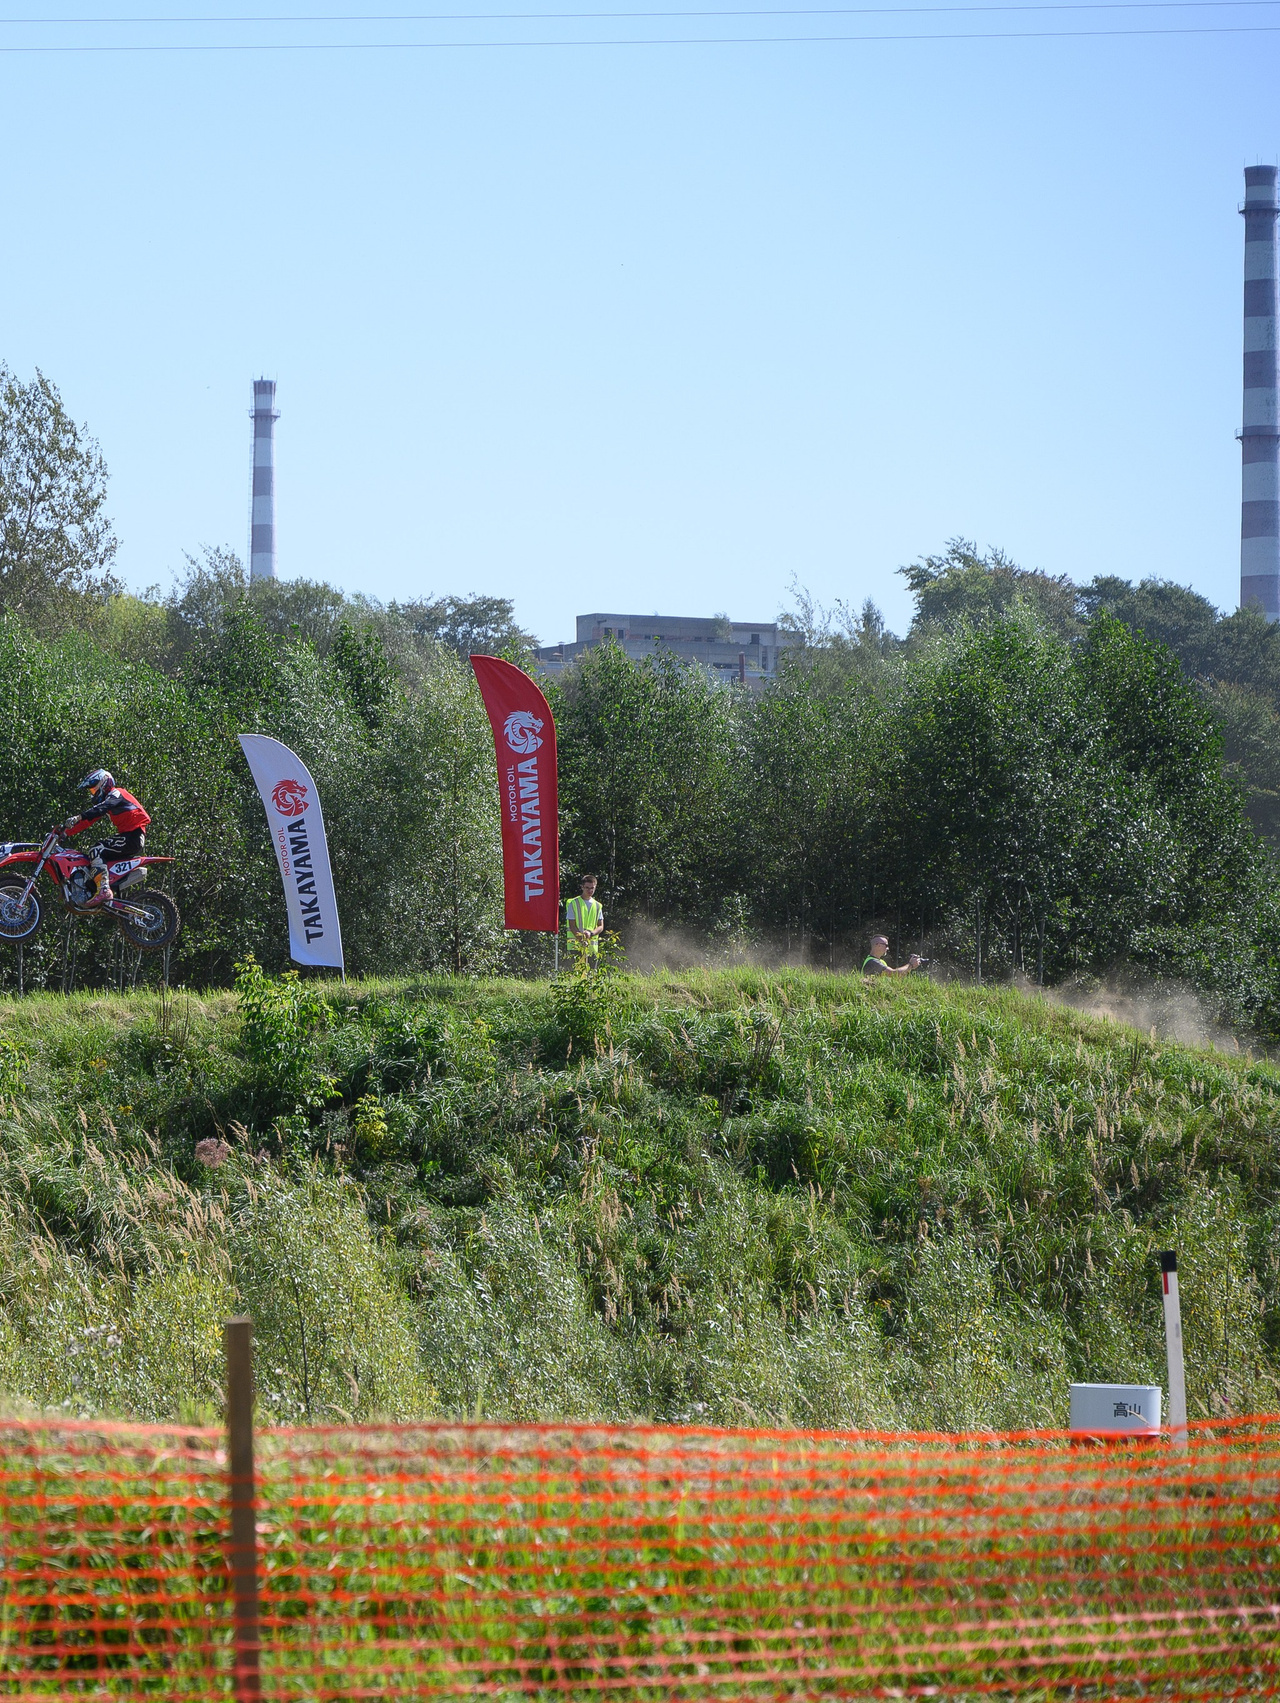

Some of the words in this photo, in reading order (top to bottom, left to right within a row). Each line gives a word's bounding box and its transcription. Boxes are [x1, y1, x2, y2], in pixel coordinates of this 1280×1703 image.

[507, 764, 515, 783] OIL
[508, 784, 518, 822] MOTOR
[278, 827, 286, 843] OIL
[517, 757, 545, 902] TAKAYAMA
[115, 861, 133, 874] 321
[280, 844, 291, 876] MOTOR
[287, 818, 324, 945] TAKAYAMA
[1113, 1401, 1141, 1418] 高山
